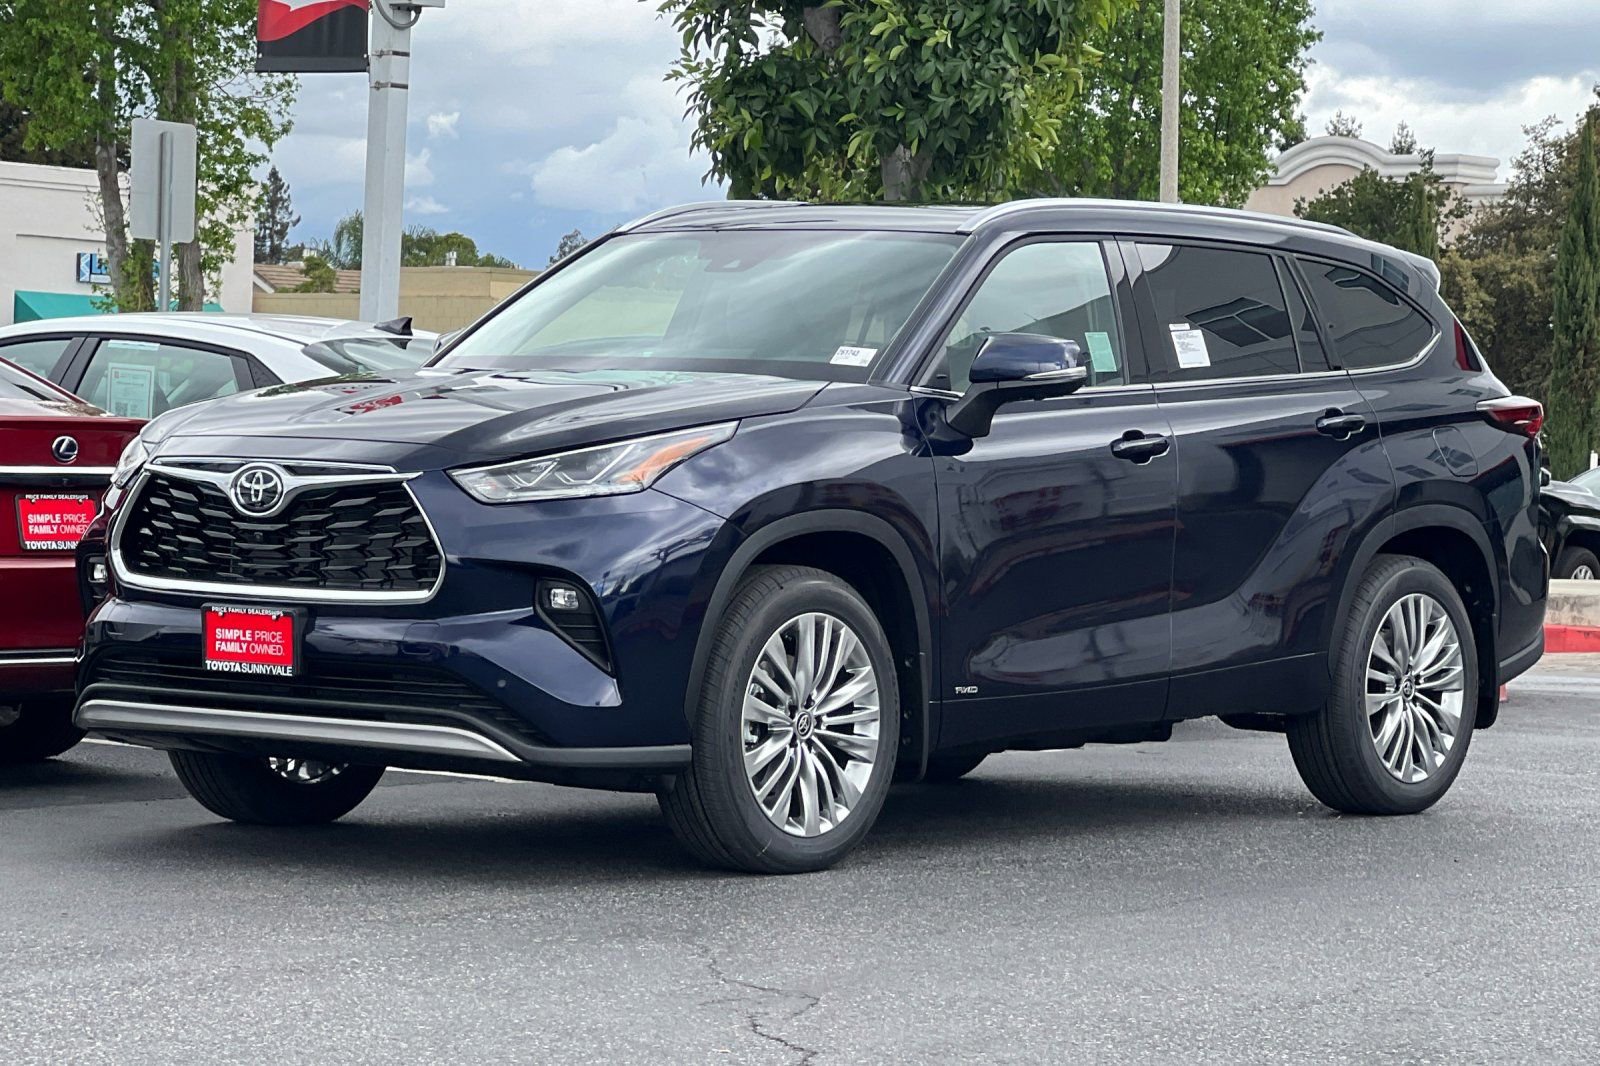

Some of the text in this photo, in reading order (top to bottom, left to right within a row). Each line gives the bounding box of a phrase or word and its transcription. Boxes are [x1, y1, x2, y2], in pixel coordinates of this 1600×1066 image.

[27, 513, 61, 524] SIMPLE
[28, 525, 58, 535] FAMILY
[24, 541, 57, 550] TOYOTA
[247, 608, 283, 617] DEALERSHIPS
[215, 628, 252, 641] SIMPLE
[215, 641, 247, 653] FAMILY
[205, 660, 292, 677] TOYOTA SUNNYVALE
